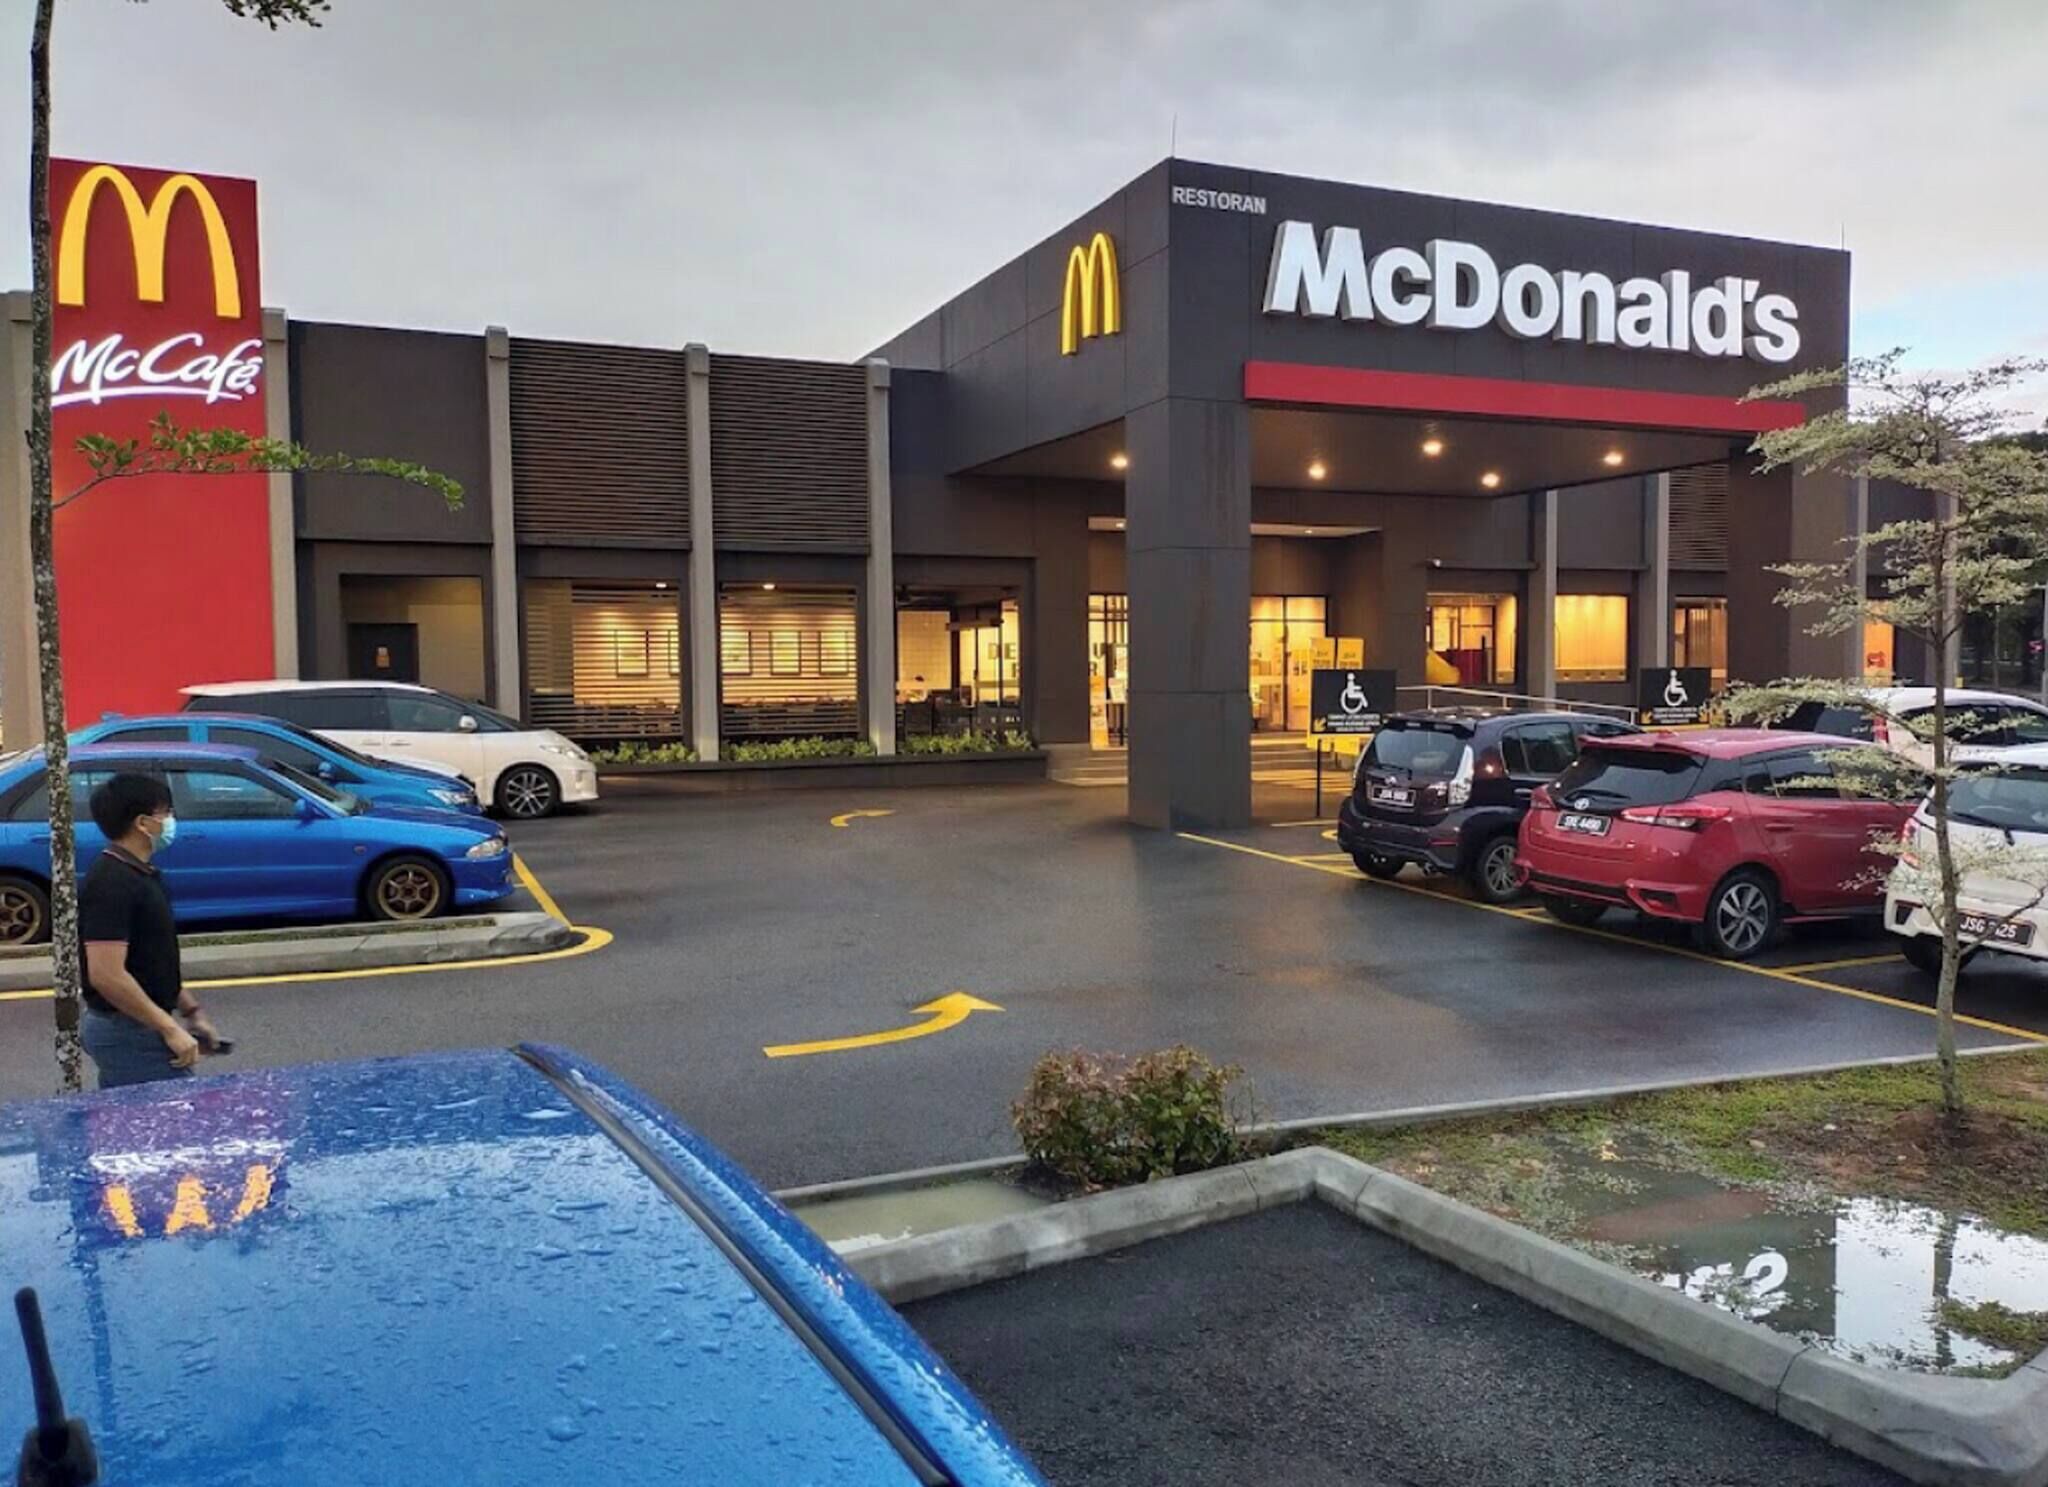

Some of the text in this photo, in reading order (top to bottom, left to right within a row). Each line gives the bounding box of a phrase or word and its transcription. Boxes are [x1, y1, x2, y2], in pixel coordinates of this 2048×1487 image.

[1172, 185, 1267, 215] RESTORAN
[1263, 220, 1800, 363] McDonald's
[51, 333, 263, 405] McCafé
[1960, 916, 1986, 933] JSG
